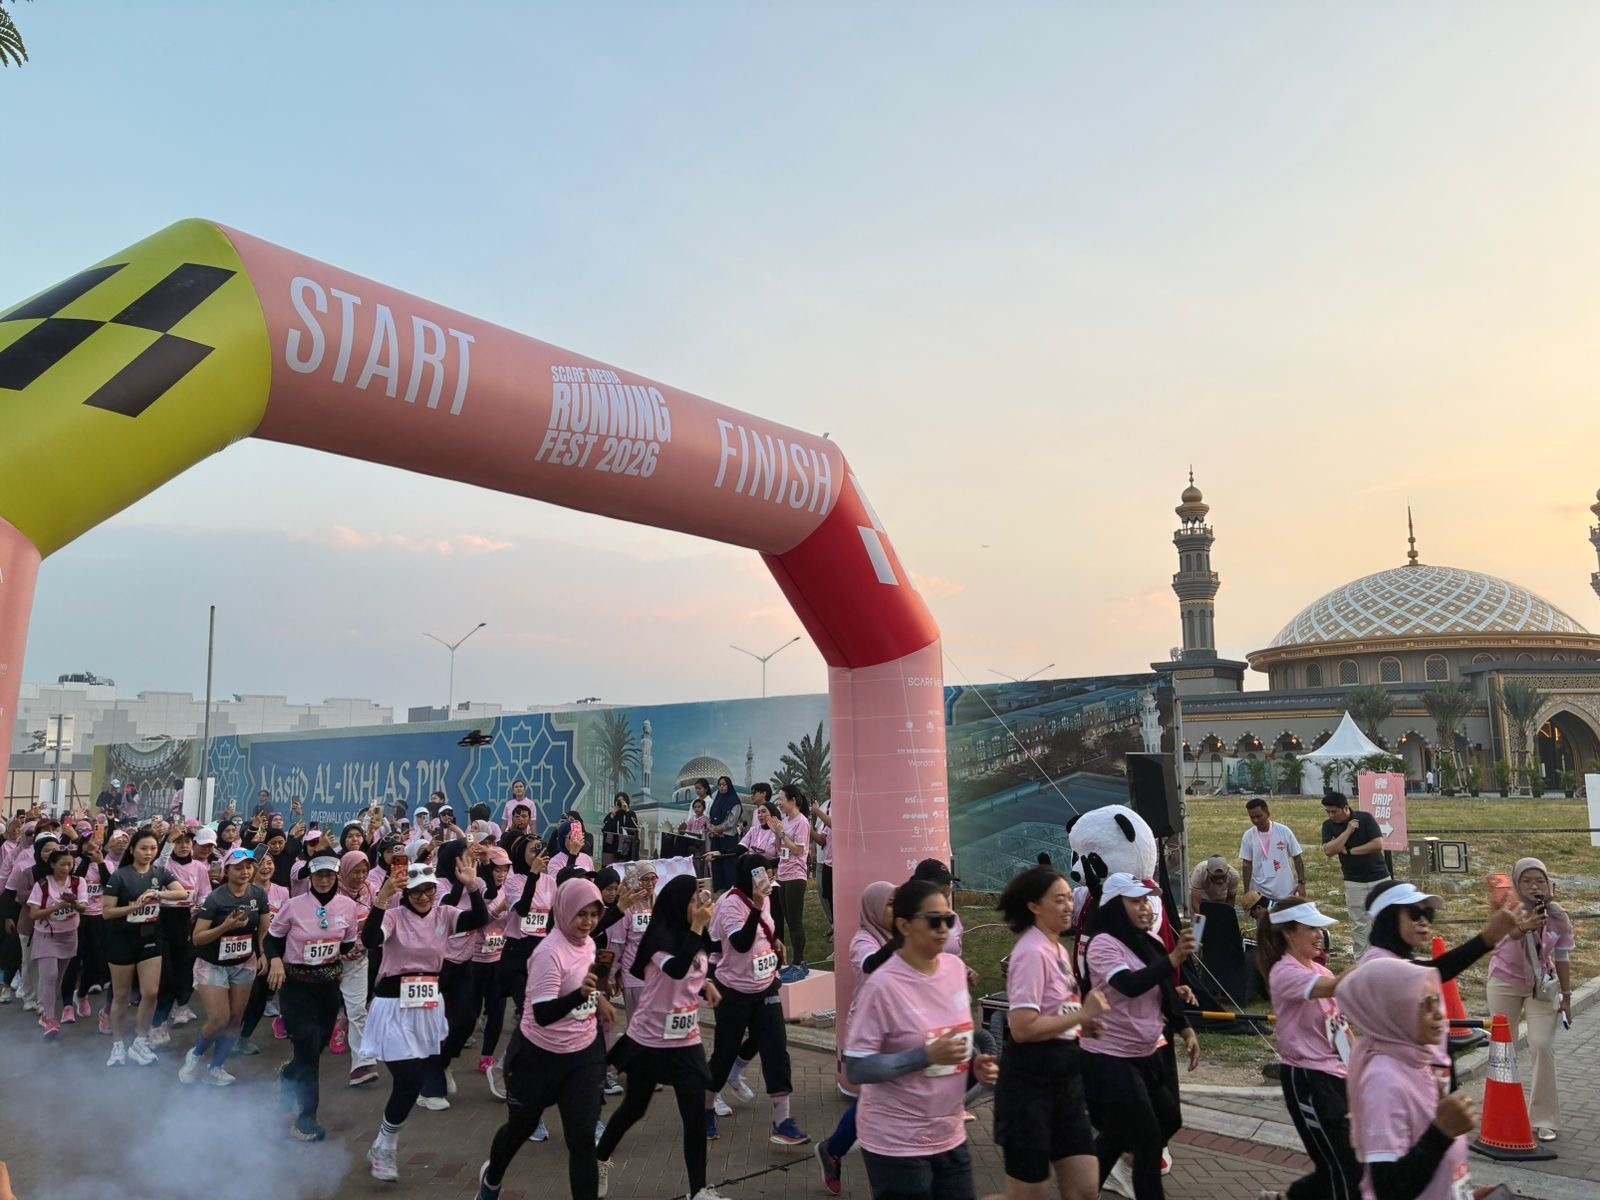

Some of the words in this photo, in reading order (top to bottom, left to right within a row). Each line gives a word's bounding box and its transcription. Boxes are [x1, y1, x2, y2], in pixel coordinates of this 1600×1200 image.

[285, 276, 476, 416] START
[551, 365, 586, 383] SCARF
[586, 367, 623, 385] MEDIA
[547, 382, 672, 443] RUNNING
[534, 430, 599, 468] FEST
[595, 437, 661, 478] 2026
[714, 417, 832, 516] FINISH
[311, 761, 411, 804] AL-IKHLAS
[416, 759, 449, 805] PIK
[1371, 793, 1393, 806] DROP
[311, 810, 343, 824] RIVERWALK
[1375, 806, 1391, 819] BAG
[526, 914, 545, 926] 5219
[225, 941, 248, 953] 5086
[310, 944, 334, 958] 5176
[758, 955, 776, 971] 5243
[408, 984, 434, 998] 5195
